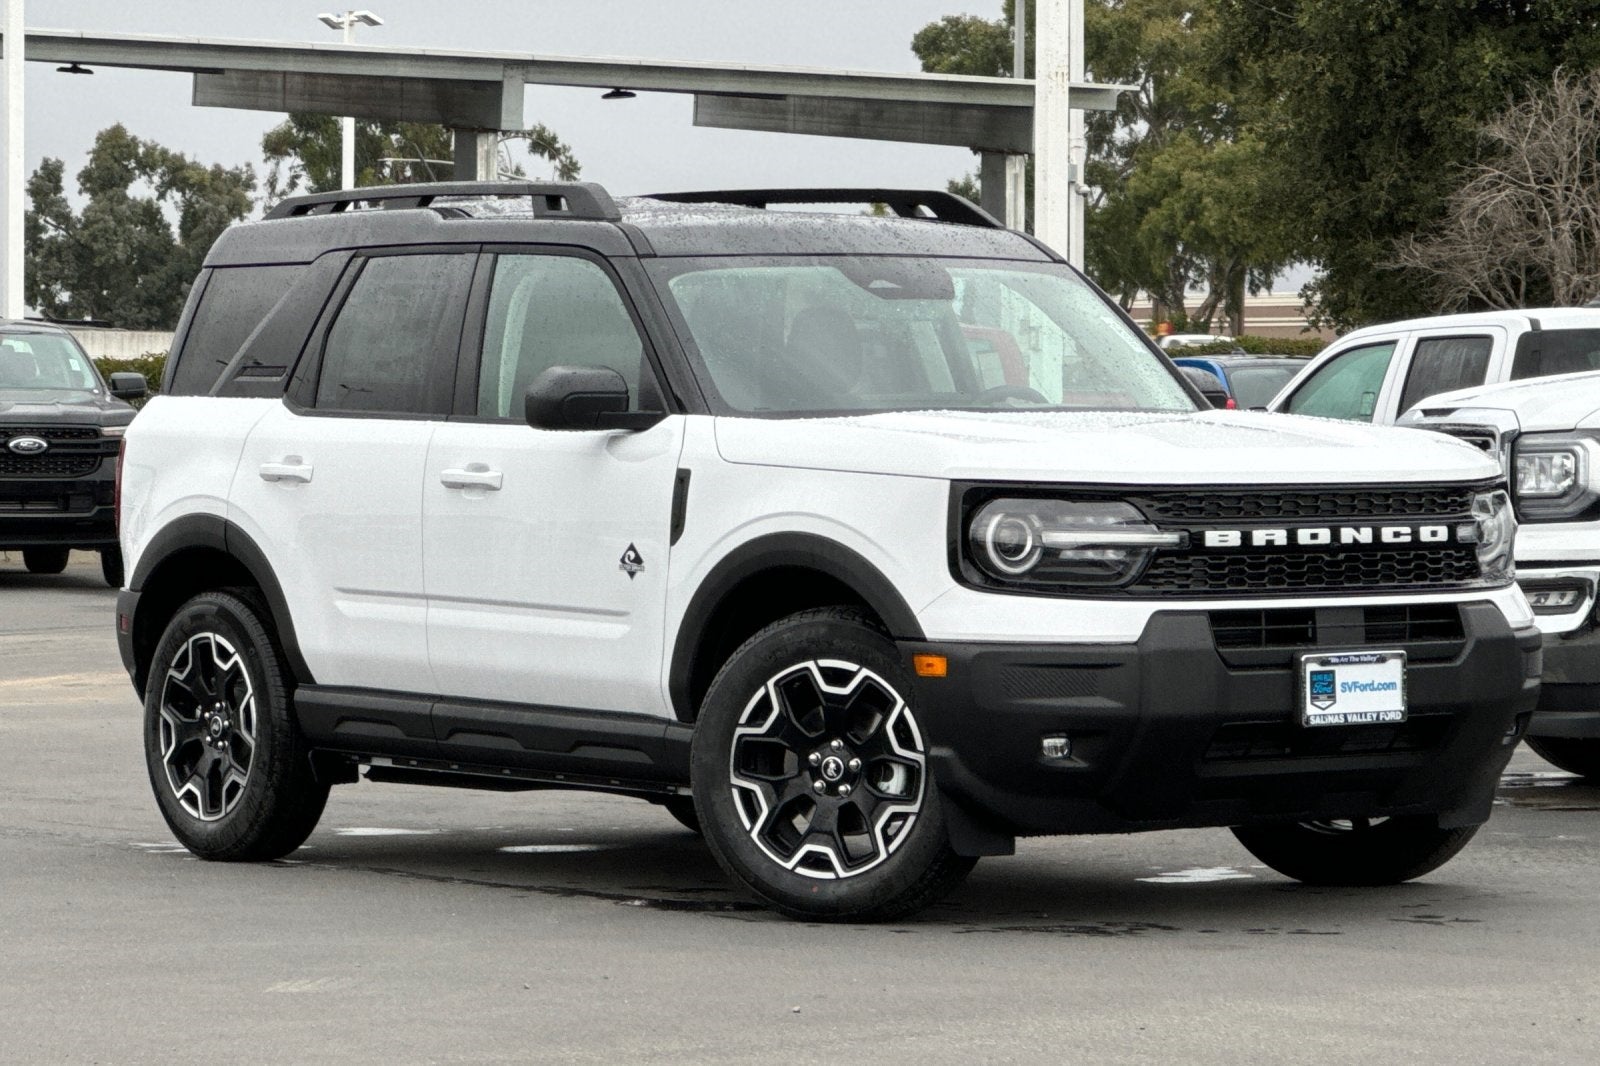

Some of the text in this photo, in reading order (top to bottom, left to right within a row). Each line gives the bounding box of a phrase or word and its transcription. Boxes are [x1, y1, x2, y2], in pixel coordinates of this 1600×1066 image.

[1204, 525, 1449, 547] BRONCO
[1312, 682, 1333, 693] Ford
[1340, 680, 1397, 693] SVFord.com
[1309, 711, 1402, 725] SALINAS VALLEY FORD
